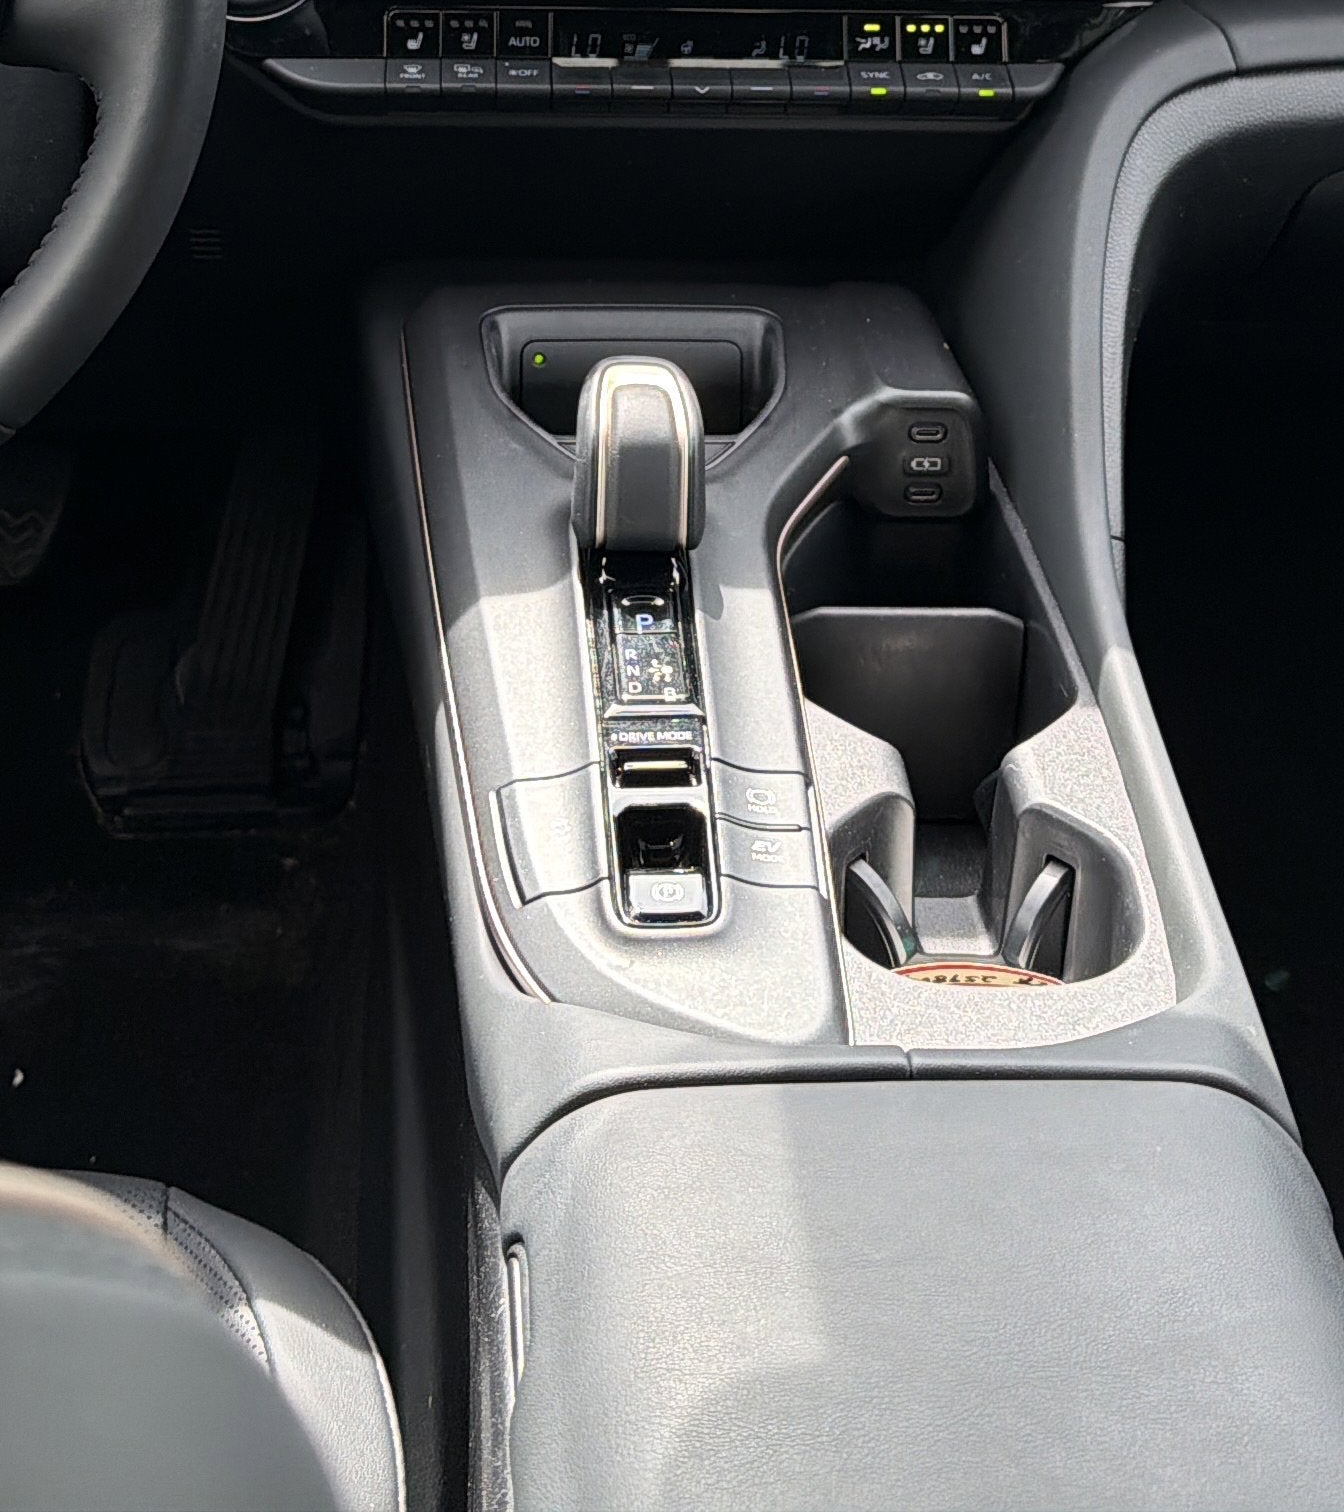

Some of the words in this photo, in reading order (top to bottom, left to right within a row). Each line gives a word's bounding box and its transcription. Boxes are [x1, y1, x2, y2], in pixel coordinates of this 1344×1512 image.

[508, 36, 540, 48] AUTO
[636, 613, 654, 634] P
[625, 648, 638, 660] R
[626, 665, 641, 677] N
[628, 681, 643, 694] D
[663, 687, 677, 702] B
[618, 731, 656, 742] DRIVE
[657, 730, 694, 741] MODE
[751, 840, 782, 852] EV
